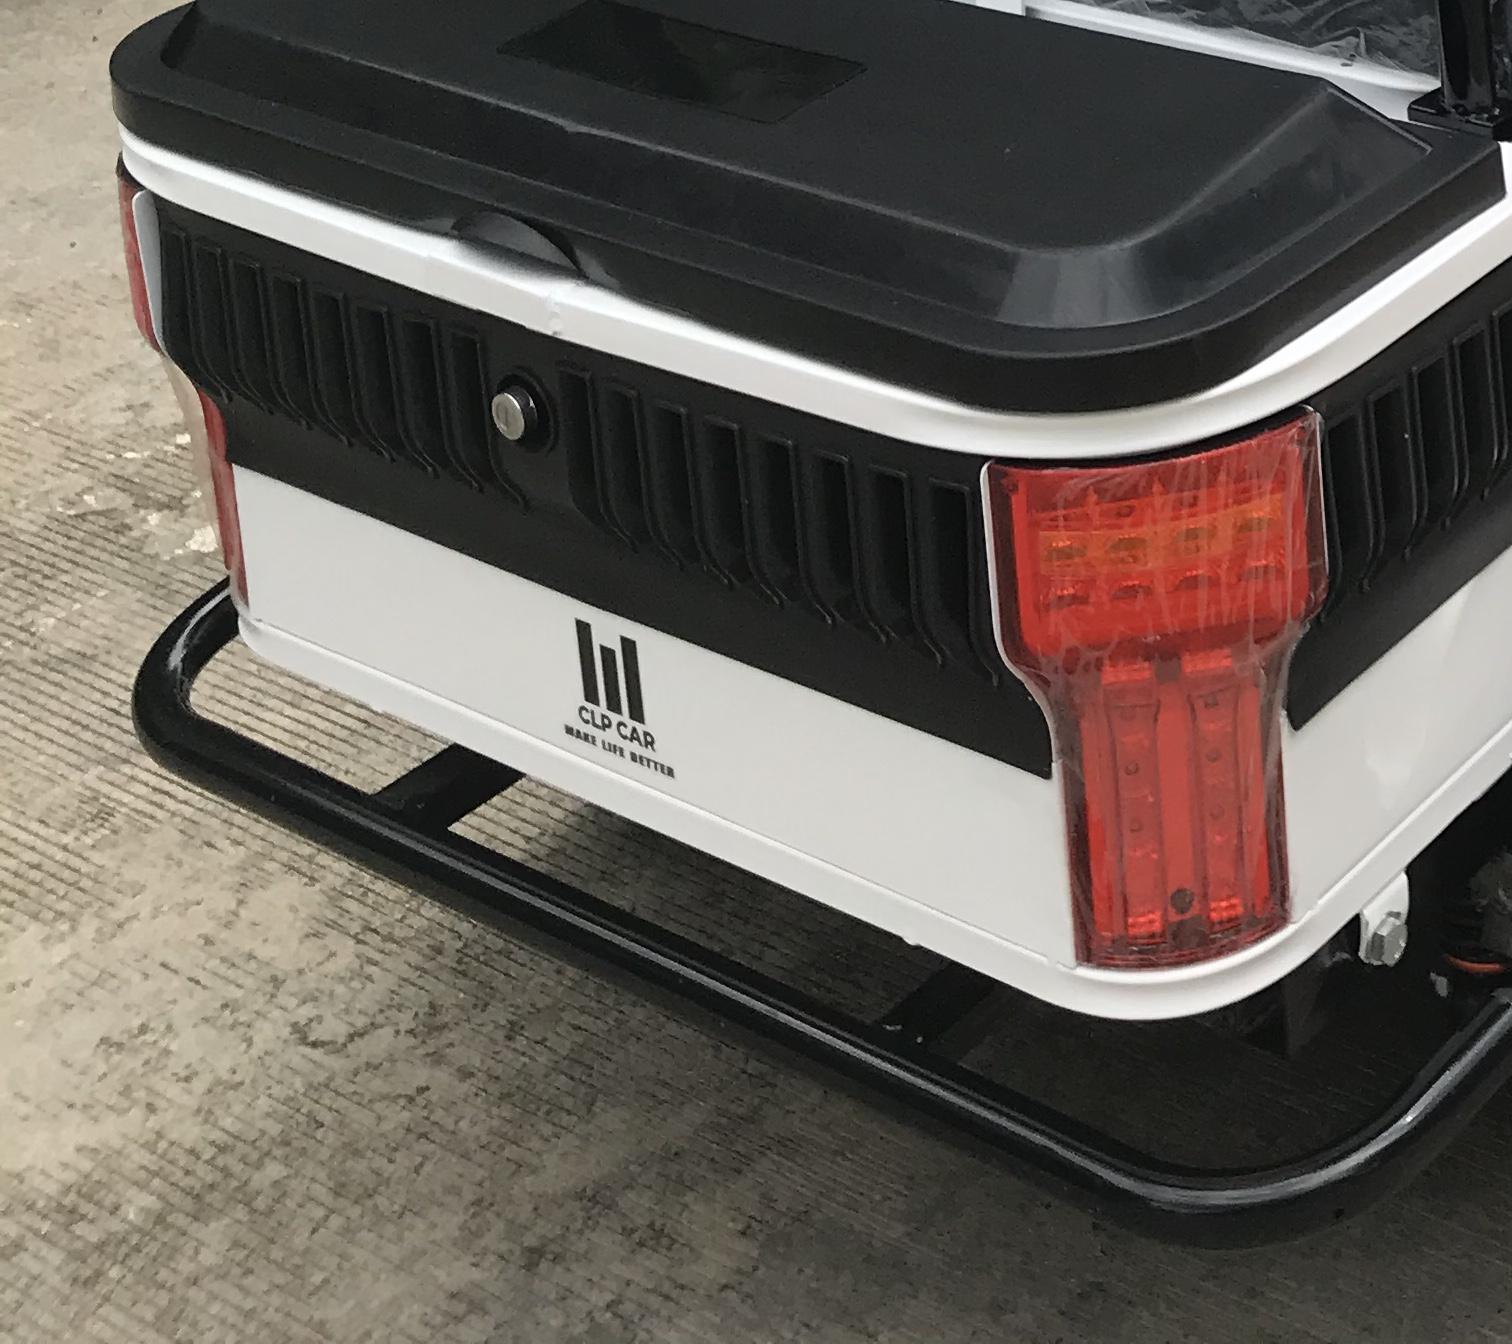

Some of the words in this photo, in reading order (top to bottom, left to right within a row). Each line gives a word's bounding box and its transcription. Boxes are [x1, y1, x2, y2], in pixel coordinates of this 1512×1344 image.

[564, 724, 598, 747] MAKE
[601, 739, 625, 759] LIFE
[629, 751, 675, 779] BETTER
[578, 705, 613, 732] CLP
[616, 720, 656, 753] CAR
